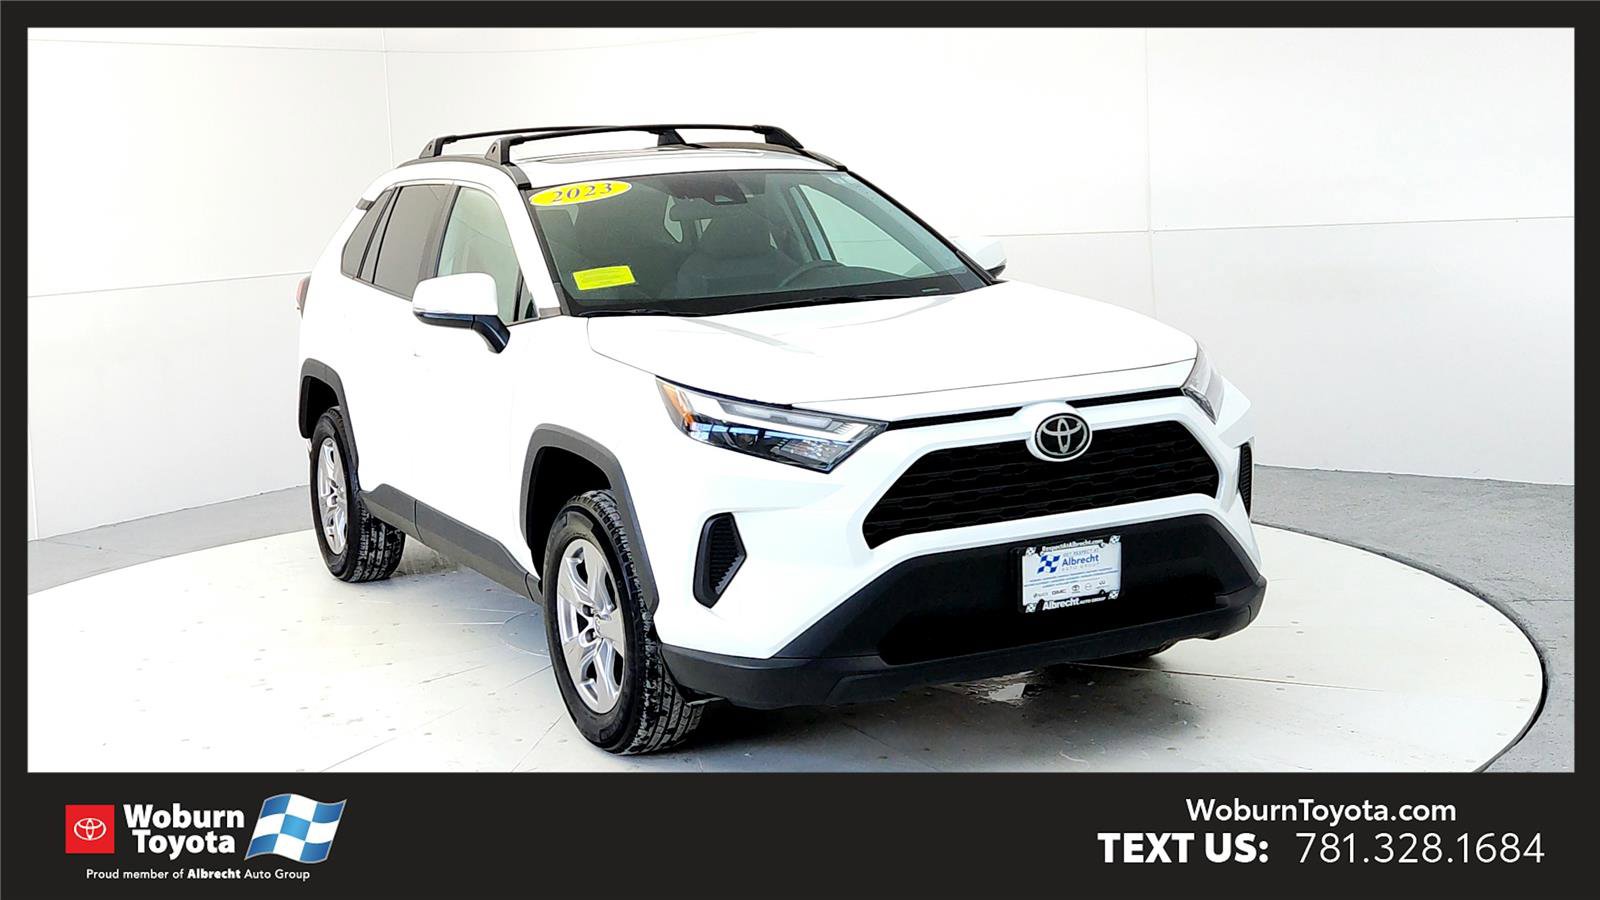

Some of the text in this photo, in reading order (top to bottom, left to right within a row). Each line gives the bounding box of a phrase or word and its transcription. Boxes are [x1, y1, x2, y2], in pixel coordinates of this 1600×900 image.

[551, 182, 614, 203] 2023
[1062, 553, 1099, 567] Albrecht
[1042, 598, 1080, 611] Albrecht
